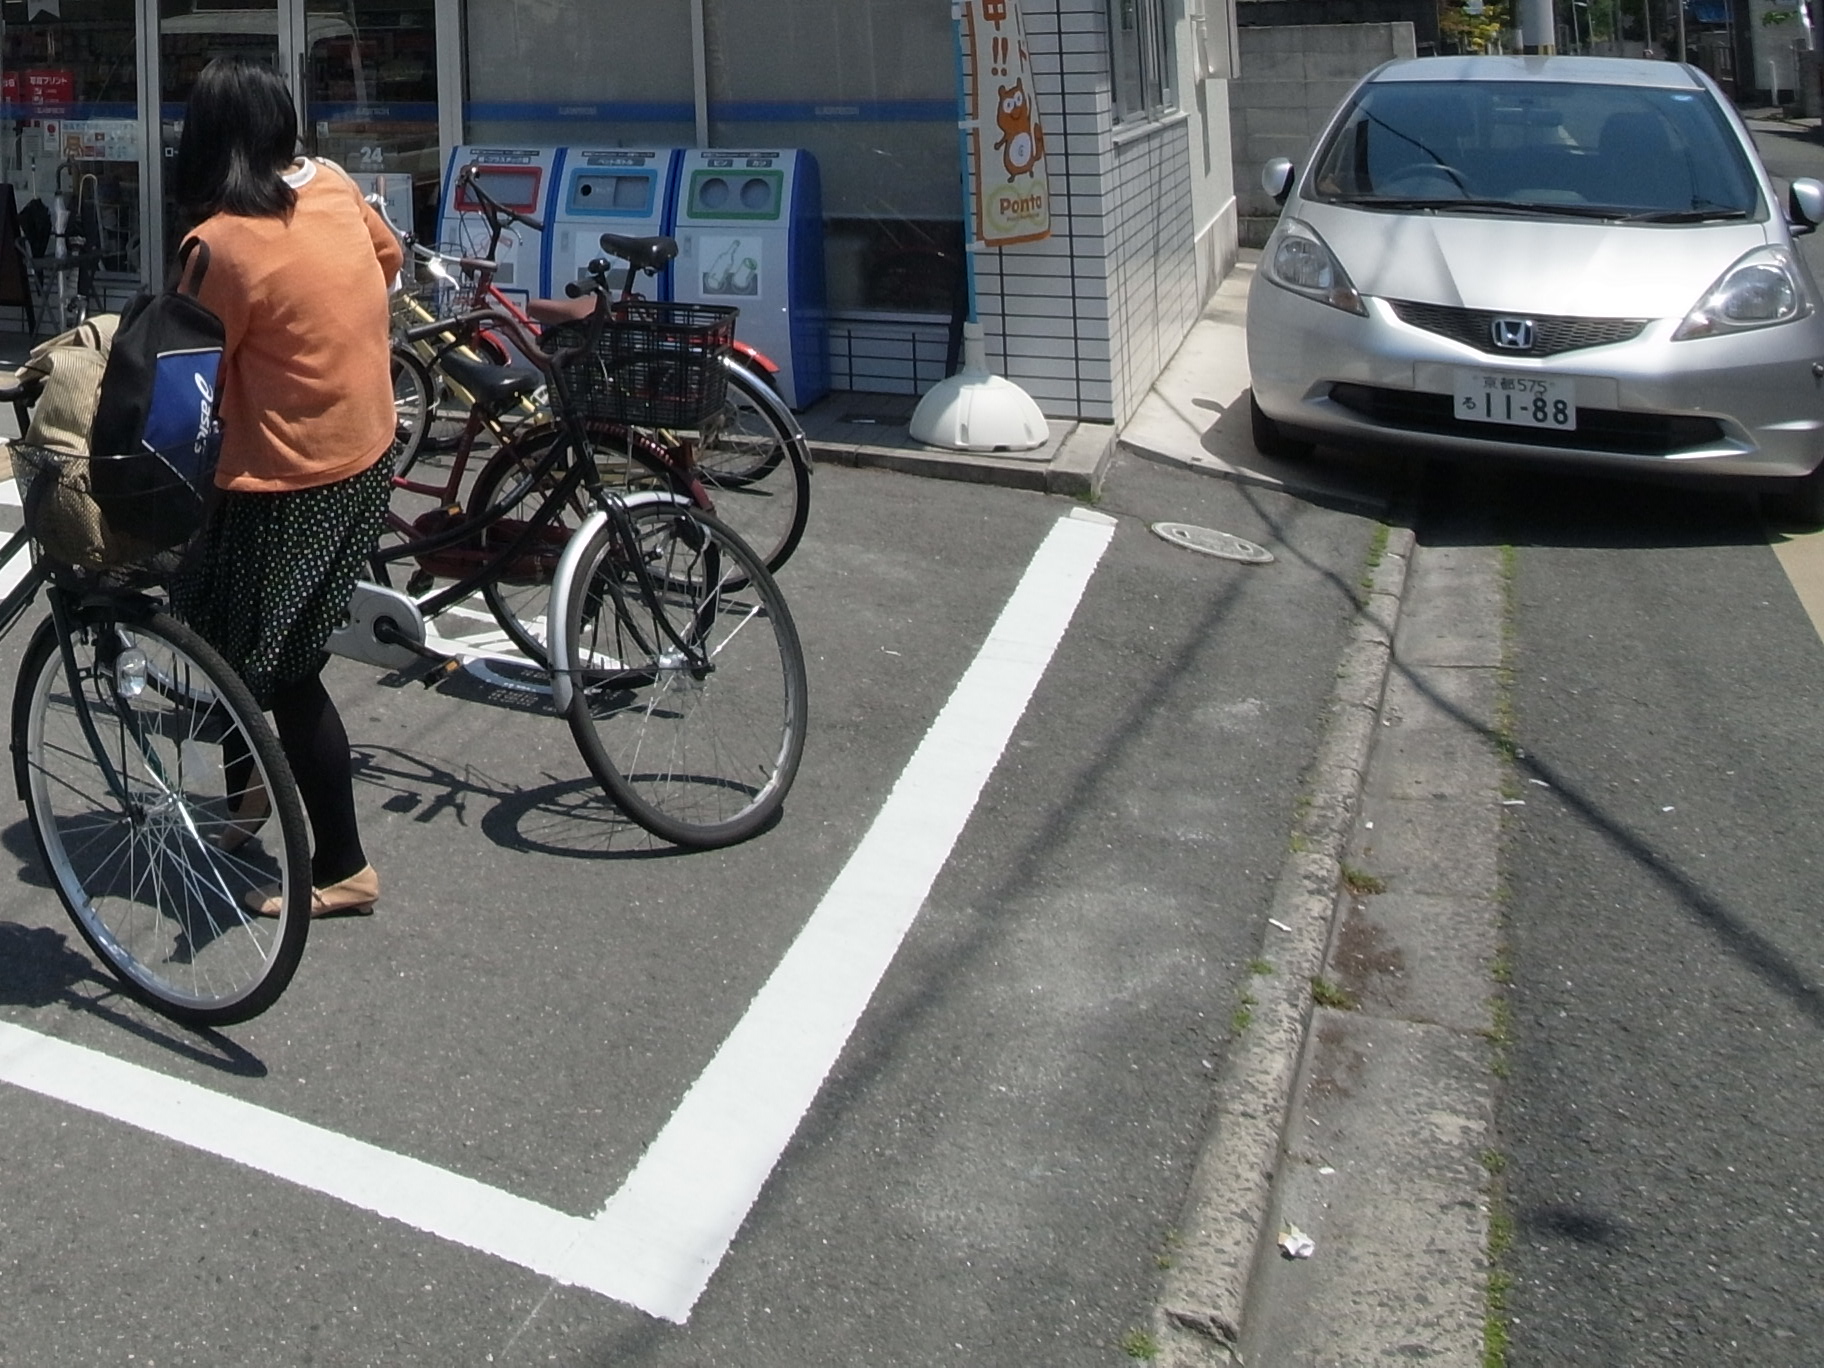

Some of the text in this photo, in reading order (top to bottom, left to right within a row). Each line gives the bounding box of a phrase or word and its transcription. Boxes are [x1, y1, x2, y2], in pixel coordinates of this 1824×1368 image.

[360, 146, 384, 163] 24
[999, 194, 1042, 216] Ponta
[1485, 393, 1569, 425] 11-88
[194, 399, 212, 454] asics
